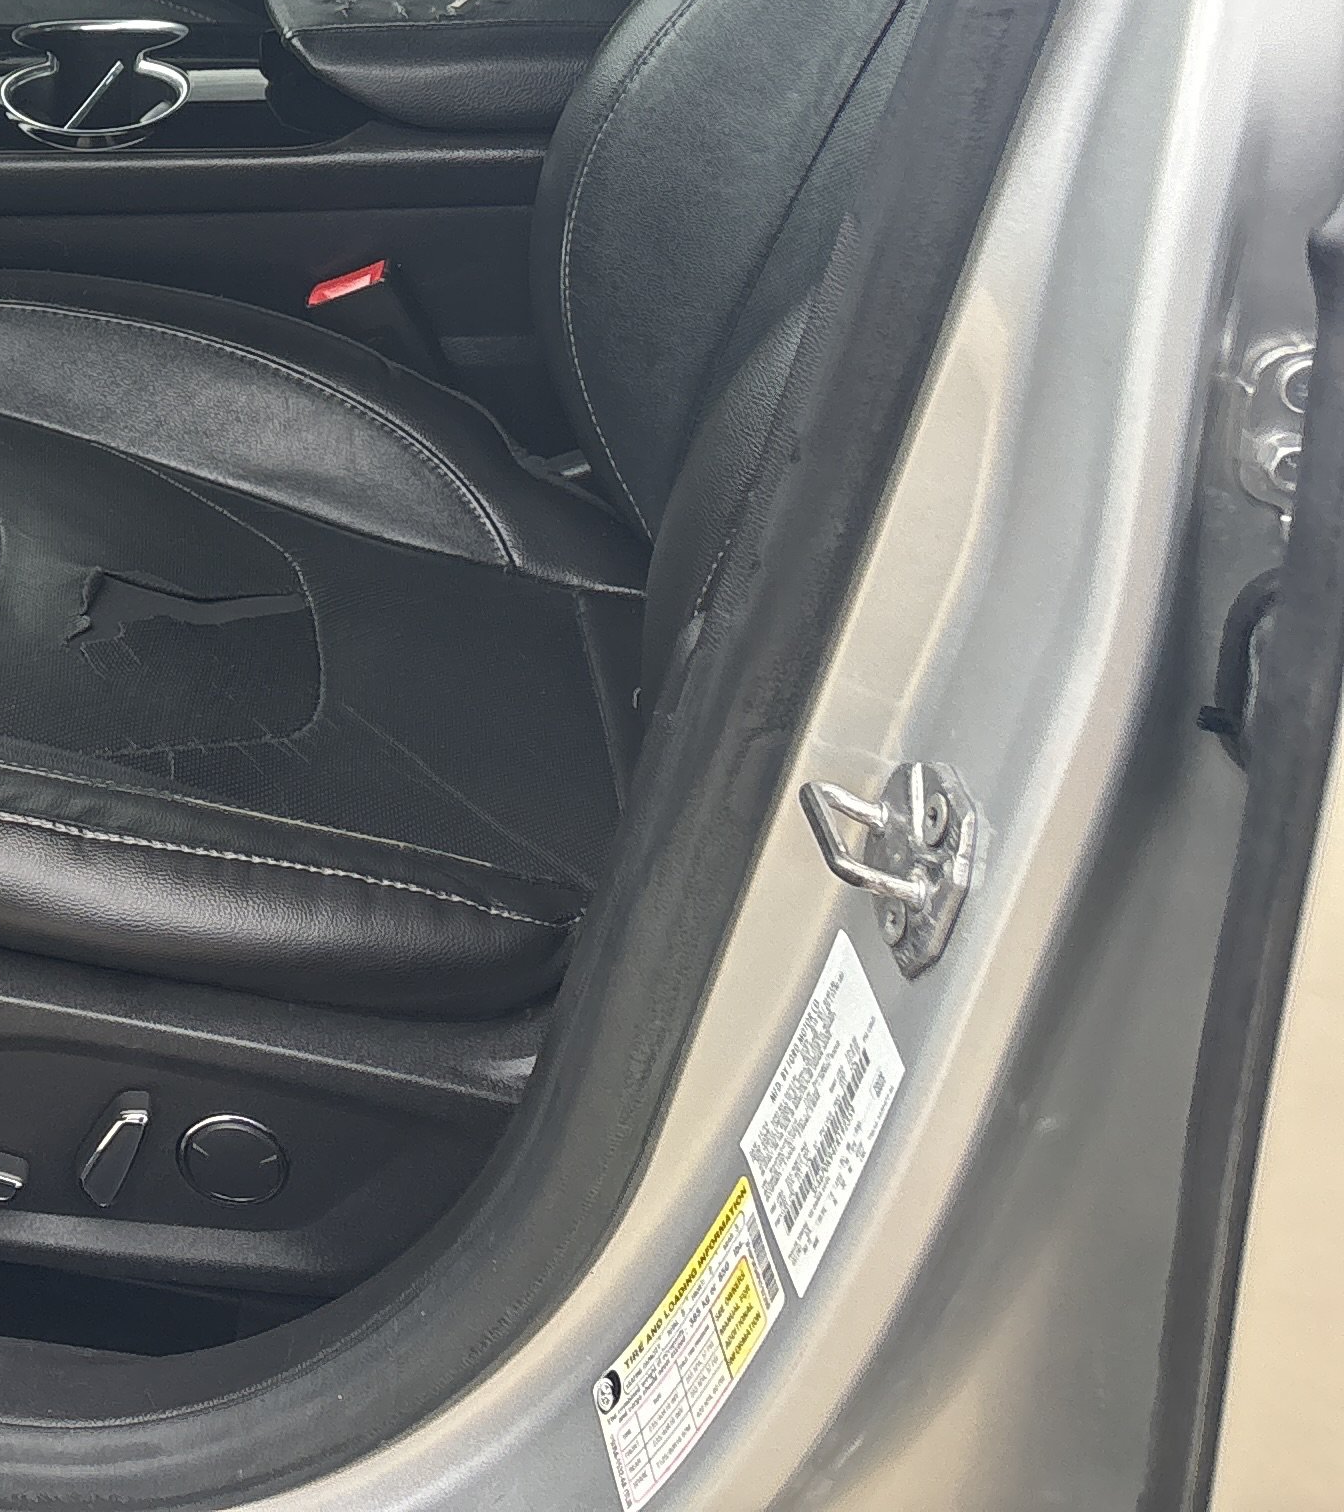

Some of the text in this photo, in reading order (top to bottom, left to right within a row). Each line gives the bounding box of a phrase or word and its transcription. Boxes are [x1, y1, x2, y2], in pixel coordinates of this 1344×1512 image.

[624, 1340, 645, 1368] TIRE
[645, 1317, 662, 1345] AND
[663, 1267, 697, 1318] LOADING
[697, 1185, 746, 1268] INFORMATION
